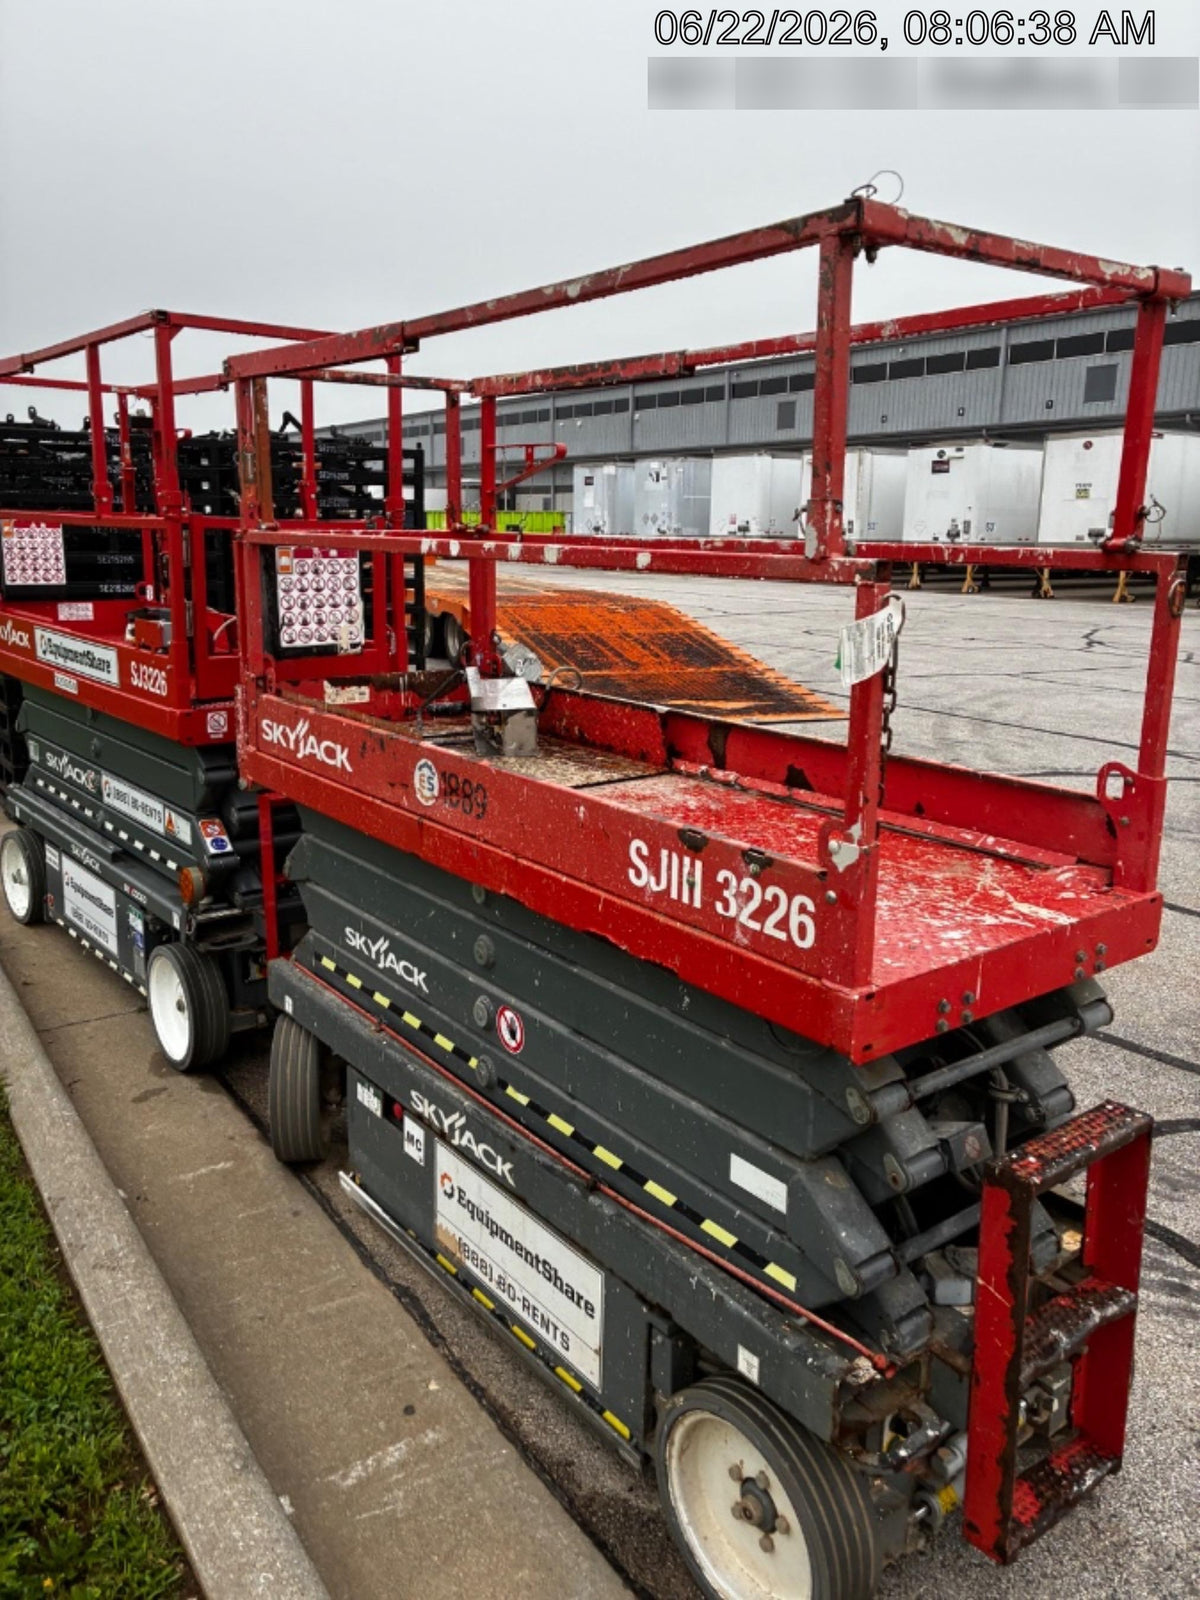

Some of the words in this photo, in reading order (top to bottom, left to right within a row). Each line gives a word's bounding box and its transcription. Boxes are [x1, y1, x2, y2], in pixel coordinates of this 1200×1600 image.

[0, 619, 31, 649] KYJACK
[46, 637, 112, 675] EquipmentShare
[130, 660, 168, 697] SJ3226
[45, 751, 89, 786] SKYJACK
[260, 718, 353, 773] SKYJACK
[440, 770, 488, 820] 1889
[714, 869, 816, 950] 3226
[344, 926, 430, 994] SKYJACK
[409, 1089, 517, 1188] SKYJACK
[456, 1185, 596, 1321] EquipmentShare
[496, 1273, 571, 1353] 80-RENTS
